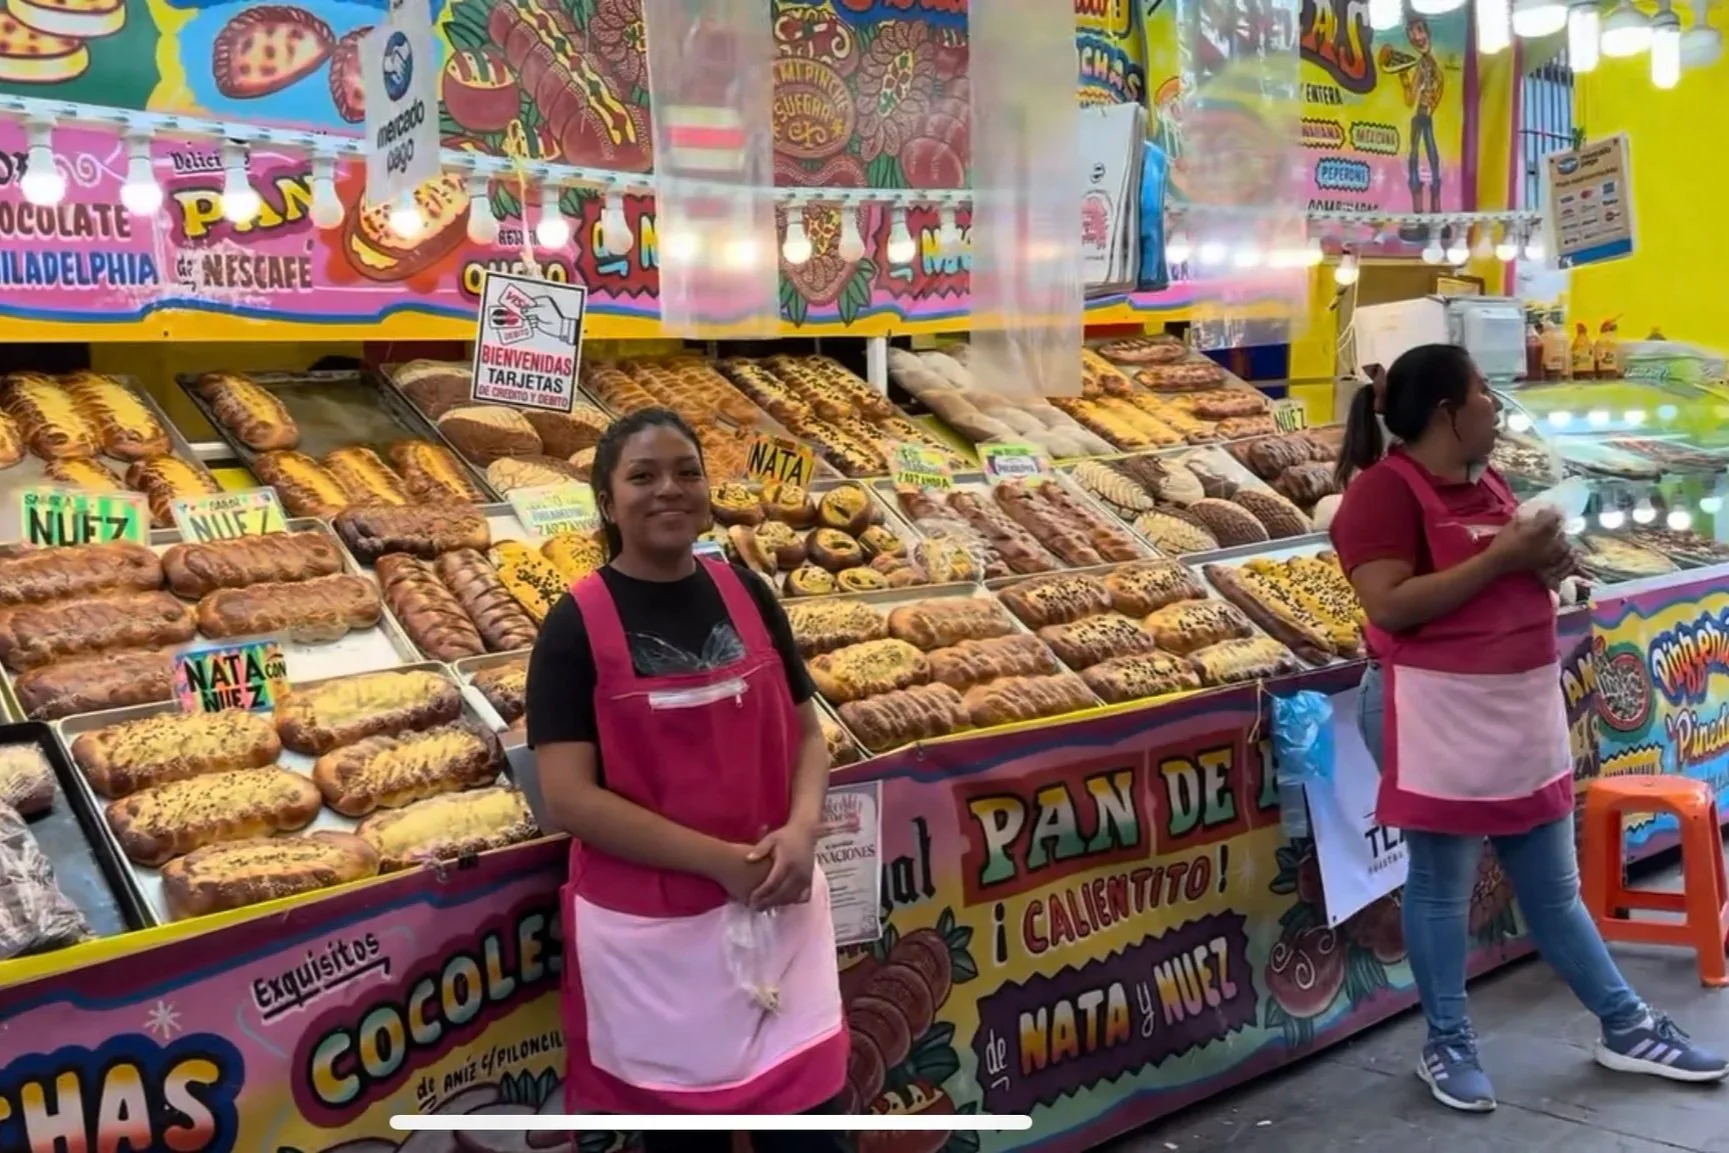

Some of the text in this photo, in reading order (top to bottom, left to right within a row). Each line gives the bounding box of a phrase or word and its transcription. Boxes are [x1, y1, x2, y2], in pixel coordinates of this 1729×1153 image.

[377, 98, 425, 149] mercado
[387, 137, 415, 177] pago
[482, 344, 573, 378] BIENVENIDAS
[488, 367, 563, 394] TARJETAS
[478, 384, 569, 408] DE CREDITO Y DEBITO
[748, 440, 804, 486] NATA
[28, 505, 129, 547] NUEZ
[189, 505, 269, 543] NUEZ
[183, 652, 287, 692] NATA CON
[201, 684, 266, 713] NUEZ
[969, 770, 1137, 885] PAN
[1161, 748, 1235, 837] DE
[253, 932, 381, 1008] Exquisitos
[986, 936, 1238, 1076] de NATA y NUEZ
[416, 1076, 436, 1101] de
